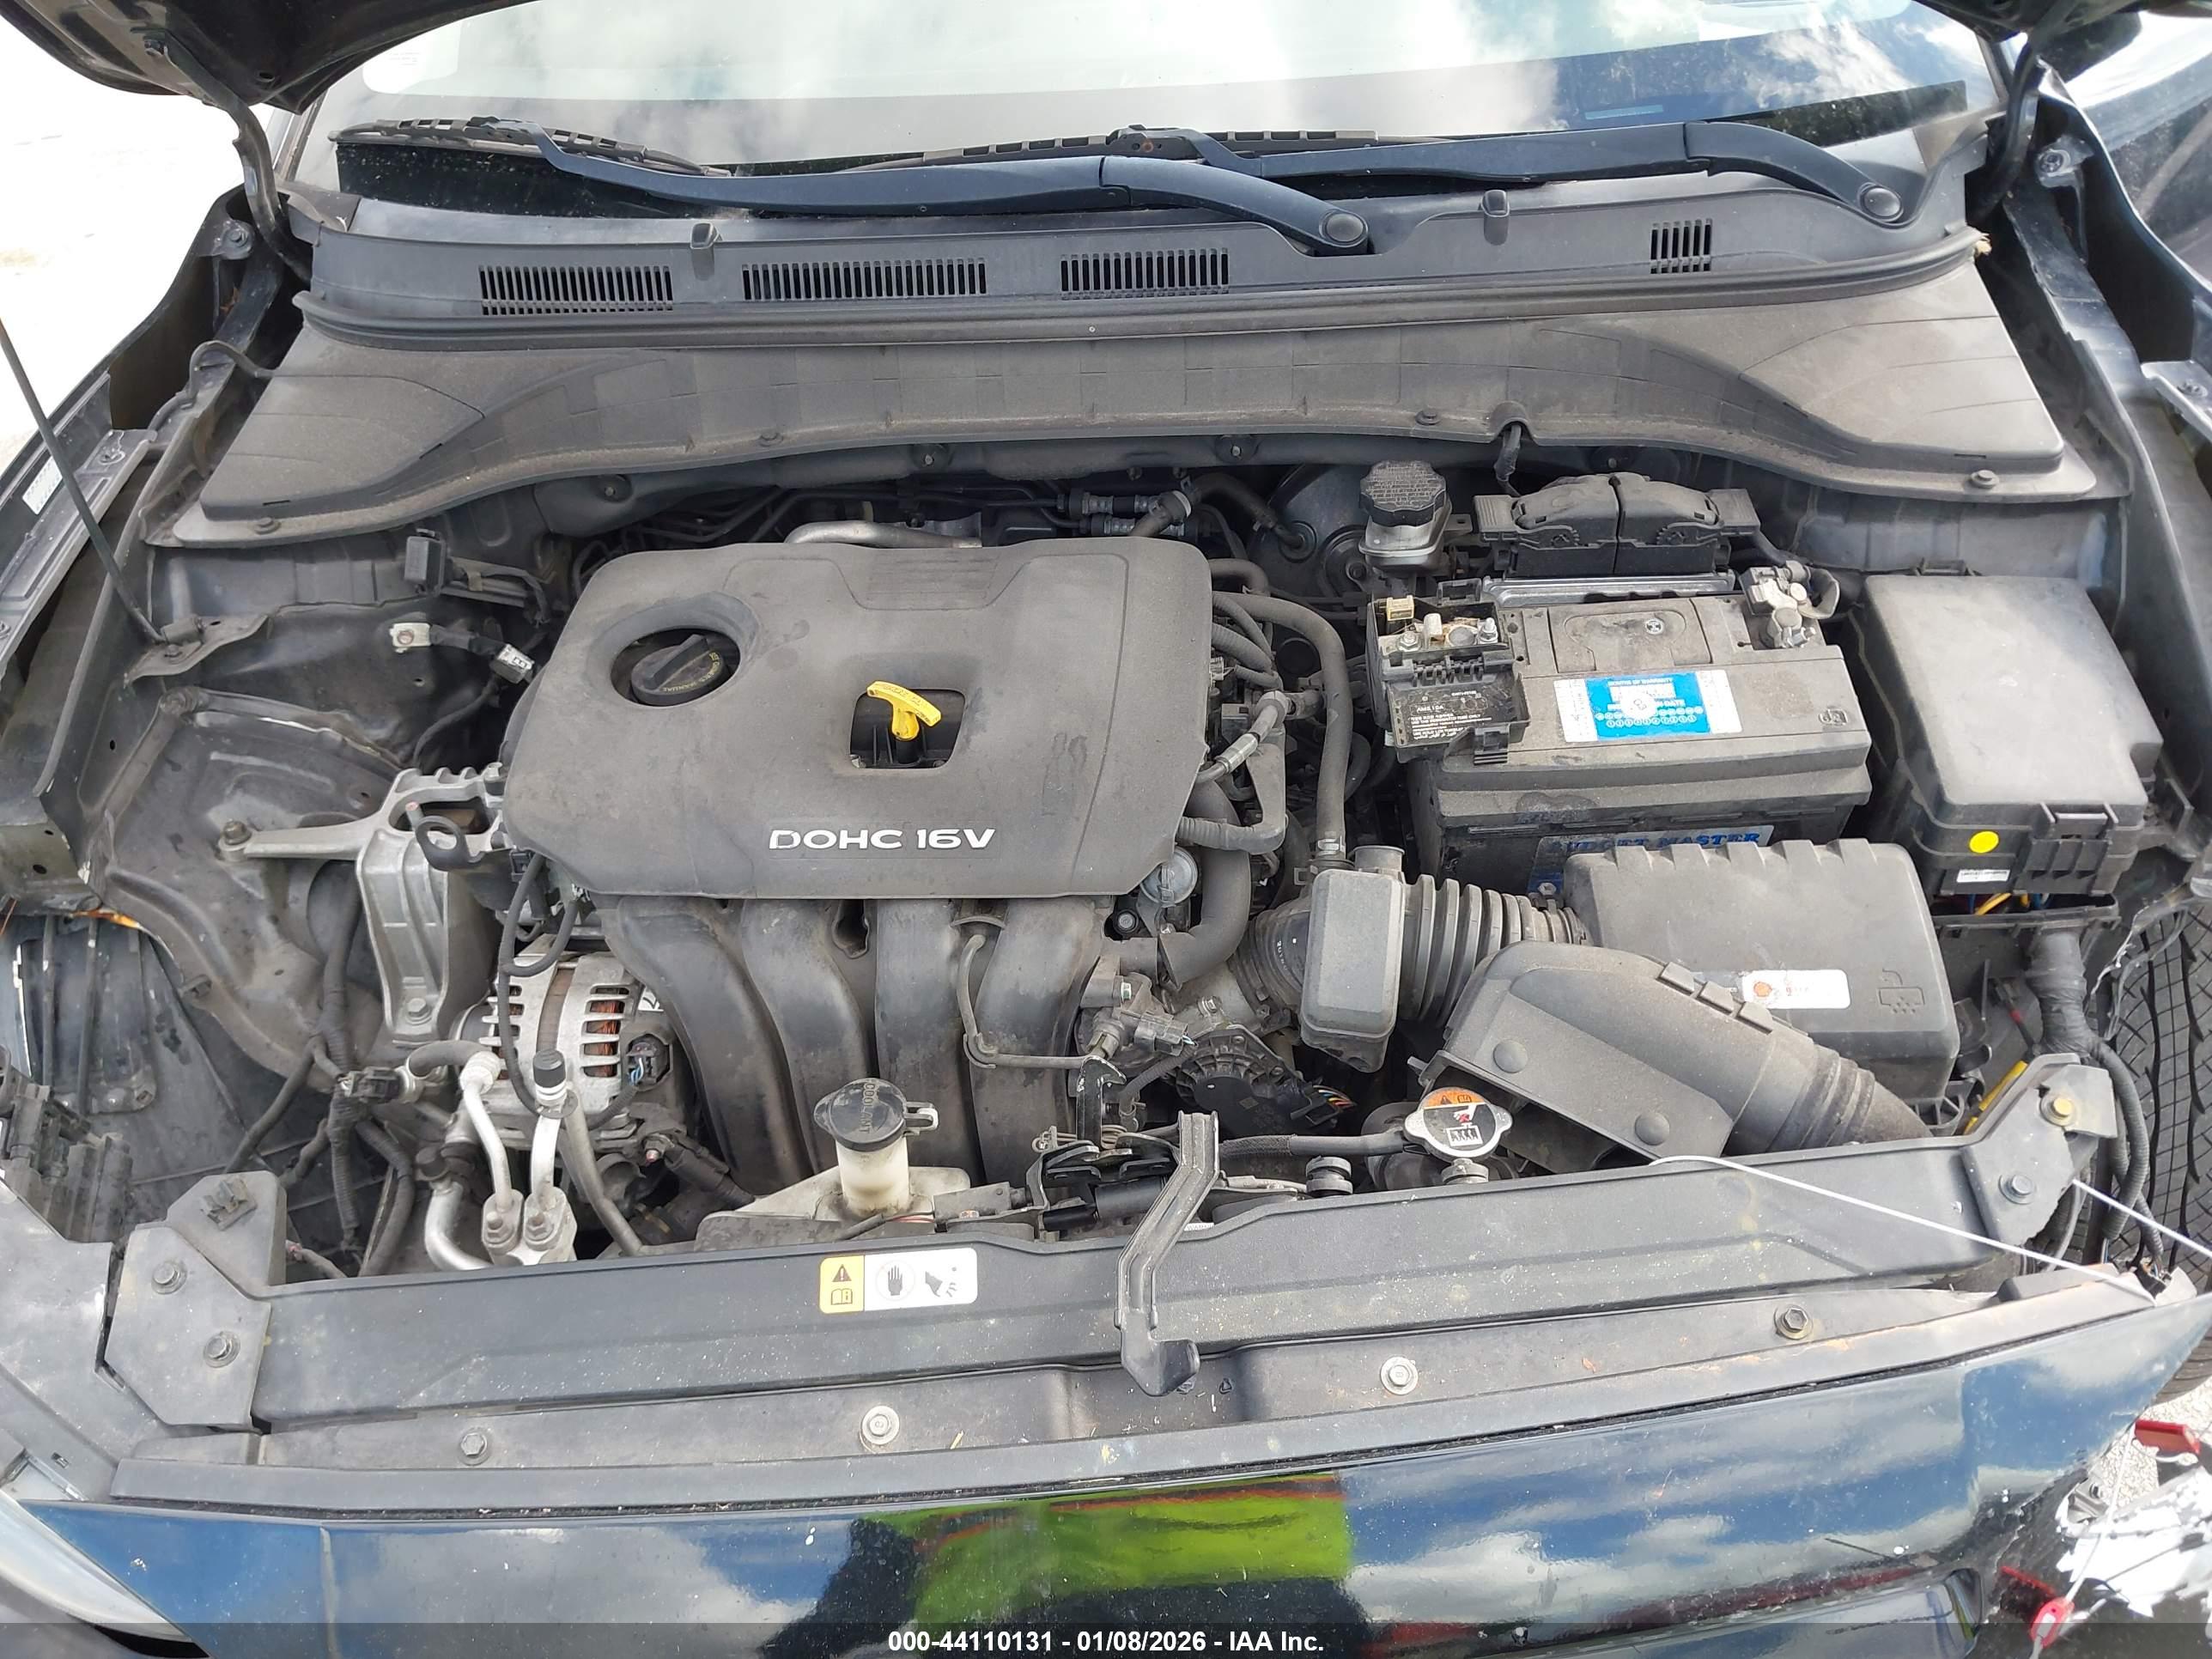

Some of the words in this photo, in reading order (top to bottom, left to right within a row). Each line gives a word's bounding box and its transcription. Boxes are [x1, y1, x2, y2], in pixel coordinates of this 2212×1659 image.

[769, 829, 903, 849] DOHC
[916, 829, 995, 849] 16V
[860, 1082, 877, 1133] COOLANT
